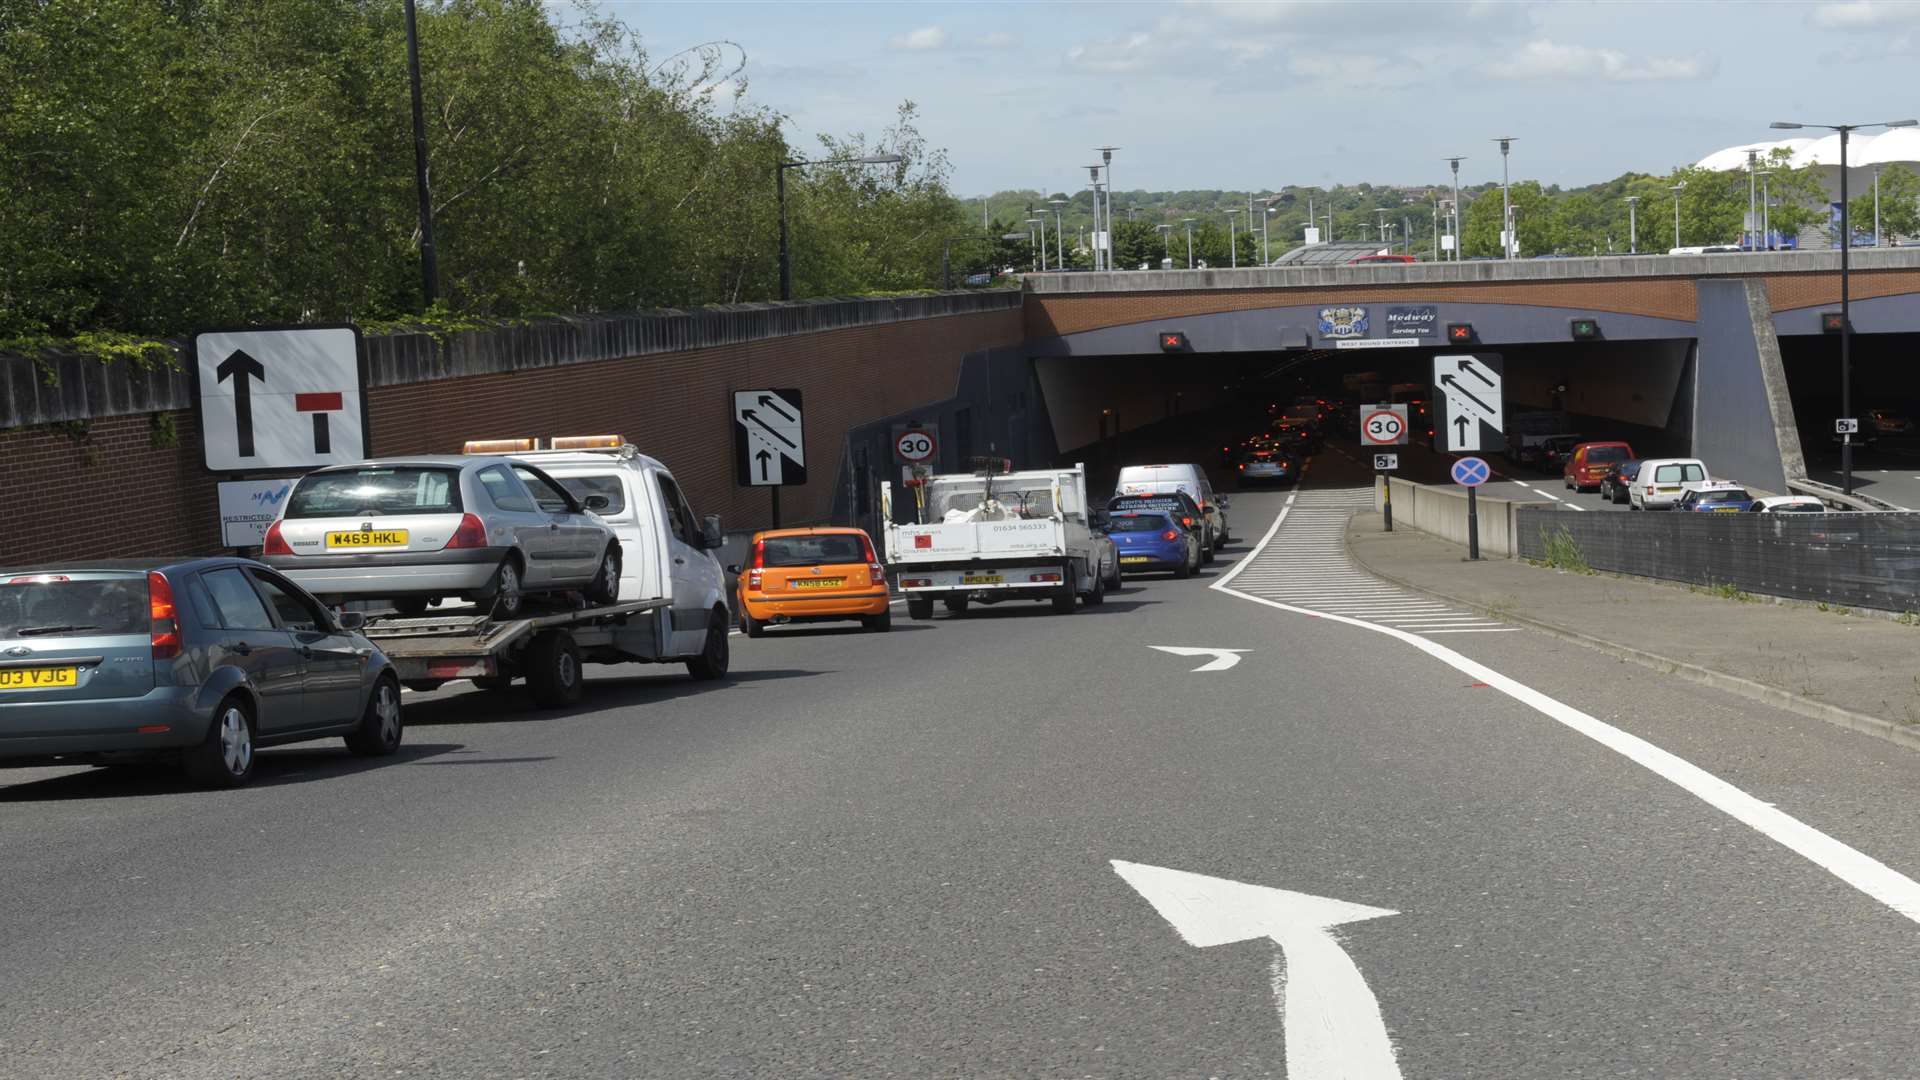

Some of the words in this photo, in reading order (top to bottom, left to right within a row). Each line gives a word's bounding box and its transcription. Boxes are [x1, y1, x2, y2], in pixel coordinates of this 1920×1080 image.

[1387, 311, 1435, 322] Medway
[1370, 420, 1400, 434] 30
[901, 440, 930, 453] 30
[334, 533, 370, 545] W469
[373, 532, 401, 544] HKL
[30, 668, 68, 683] VJG
